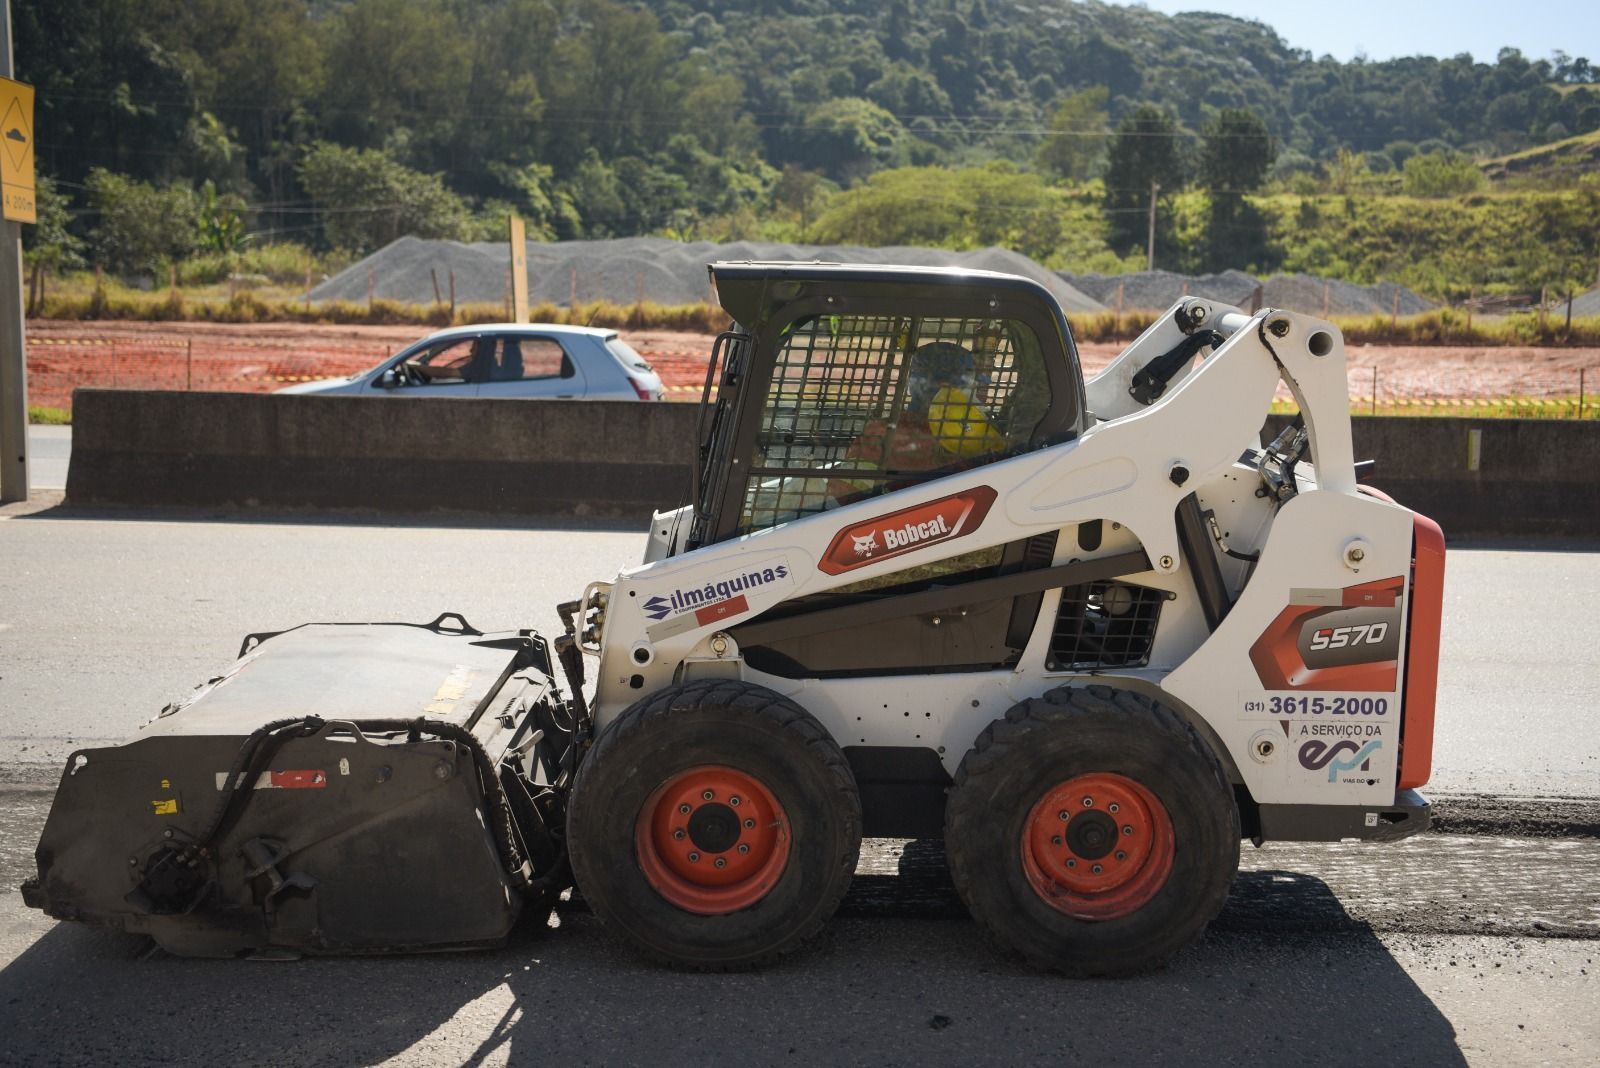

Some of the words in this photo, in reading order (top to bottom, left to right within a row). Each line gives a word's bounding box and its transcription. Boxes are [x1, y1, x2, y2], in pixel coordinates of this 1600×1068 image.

[883, 514, 948, 550] Bobcat
[1310, 622, 1388, 651] S570
[1245, 702, 1265, 713] (31)
[1269, 696, 1388, 716] 3615-2000
[1300, 725, 1308, 736] A
[1311, 725, 1362, 738] SERVIÇO
[1365, 726, 1382, 737] DA
